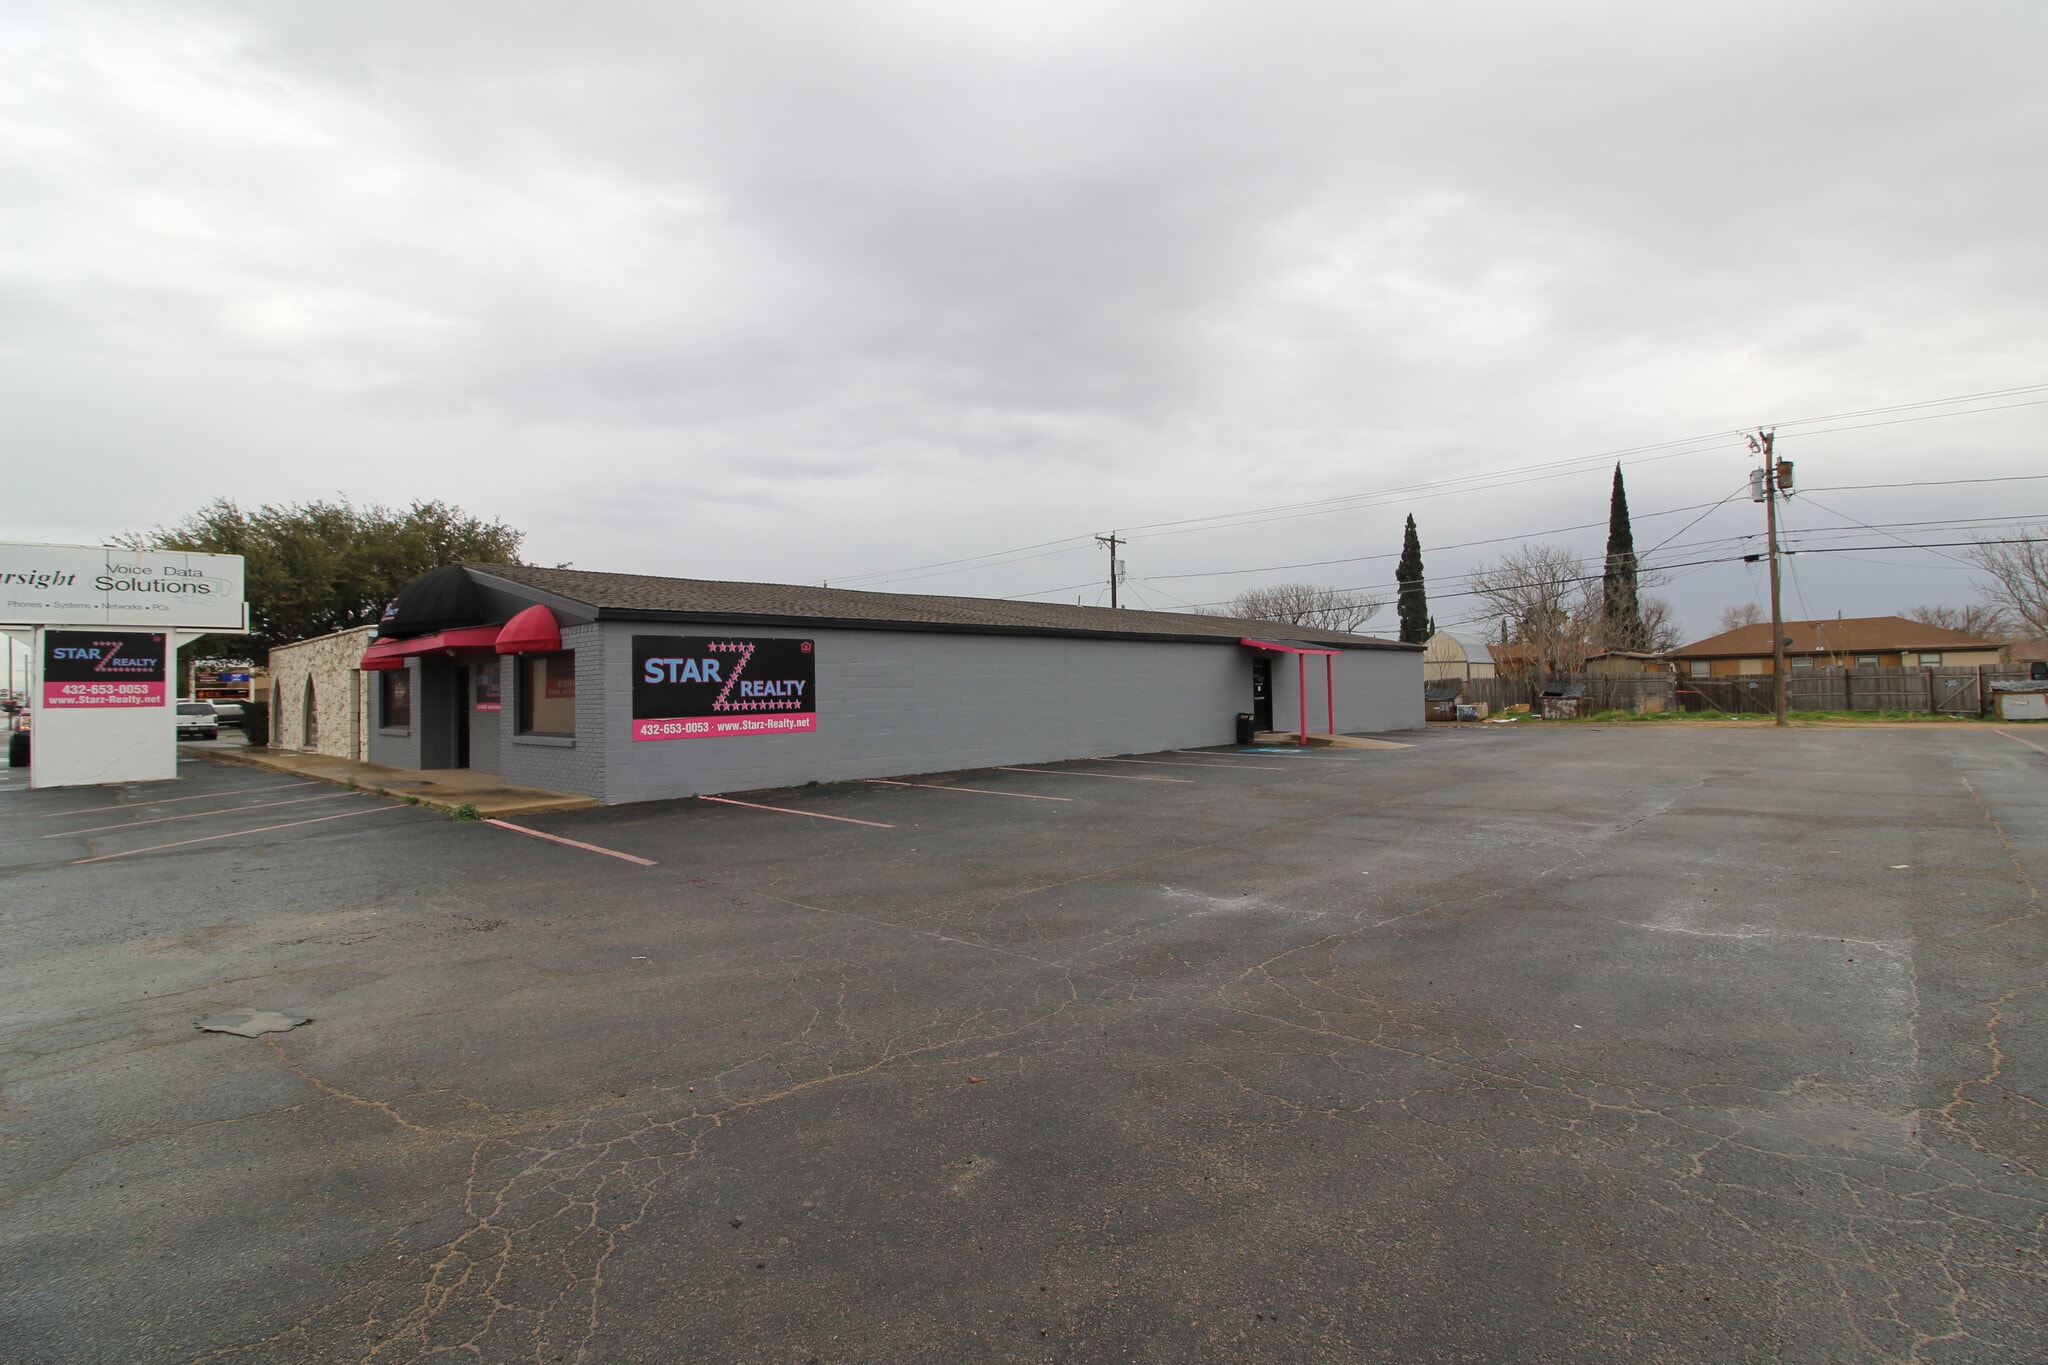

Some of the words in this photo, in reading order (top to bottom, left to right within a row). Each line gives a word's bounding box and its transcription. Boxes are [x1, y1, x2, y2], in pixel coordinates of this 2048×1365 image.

[106, 563, 153, 575] Voice
[164, 566, 204, 578] Data
[95, 576, 211, 595] Solutions
[8, 601, 42, 609] Phones
[54, 601, 91, 611] Systems
[102, 603, 143, 611] Networks
[54, 647, 102, 660] STAR
[113, 658, 158, 668] REALTY
[643, 657, 723, 684] STAR
[740, 679, 806, 697] REALTY
[62, 684, 149, 695] 432-653-0053
[48, 694, 161, 705] www.Starz-Realty.net
[640, 721, 710, 736] 432-653-0053
[716, 716, 811, 732] www.Starz-Realty.net
